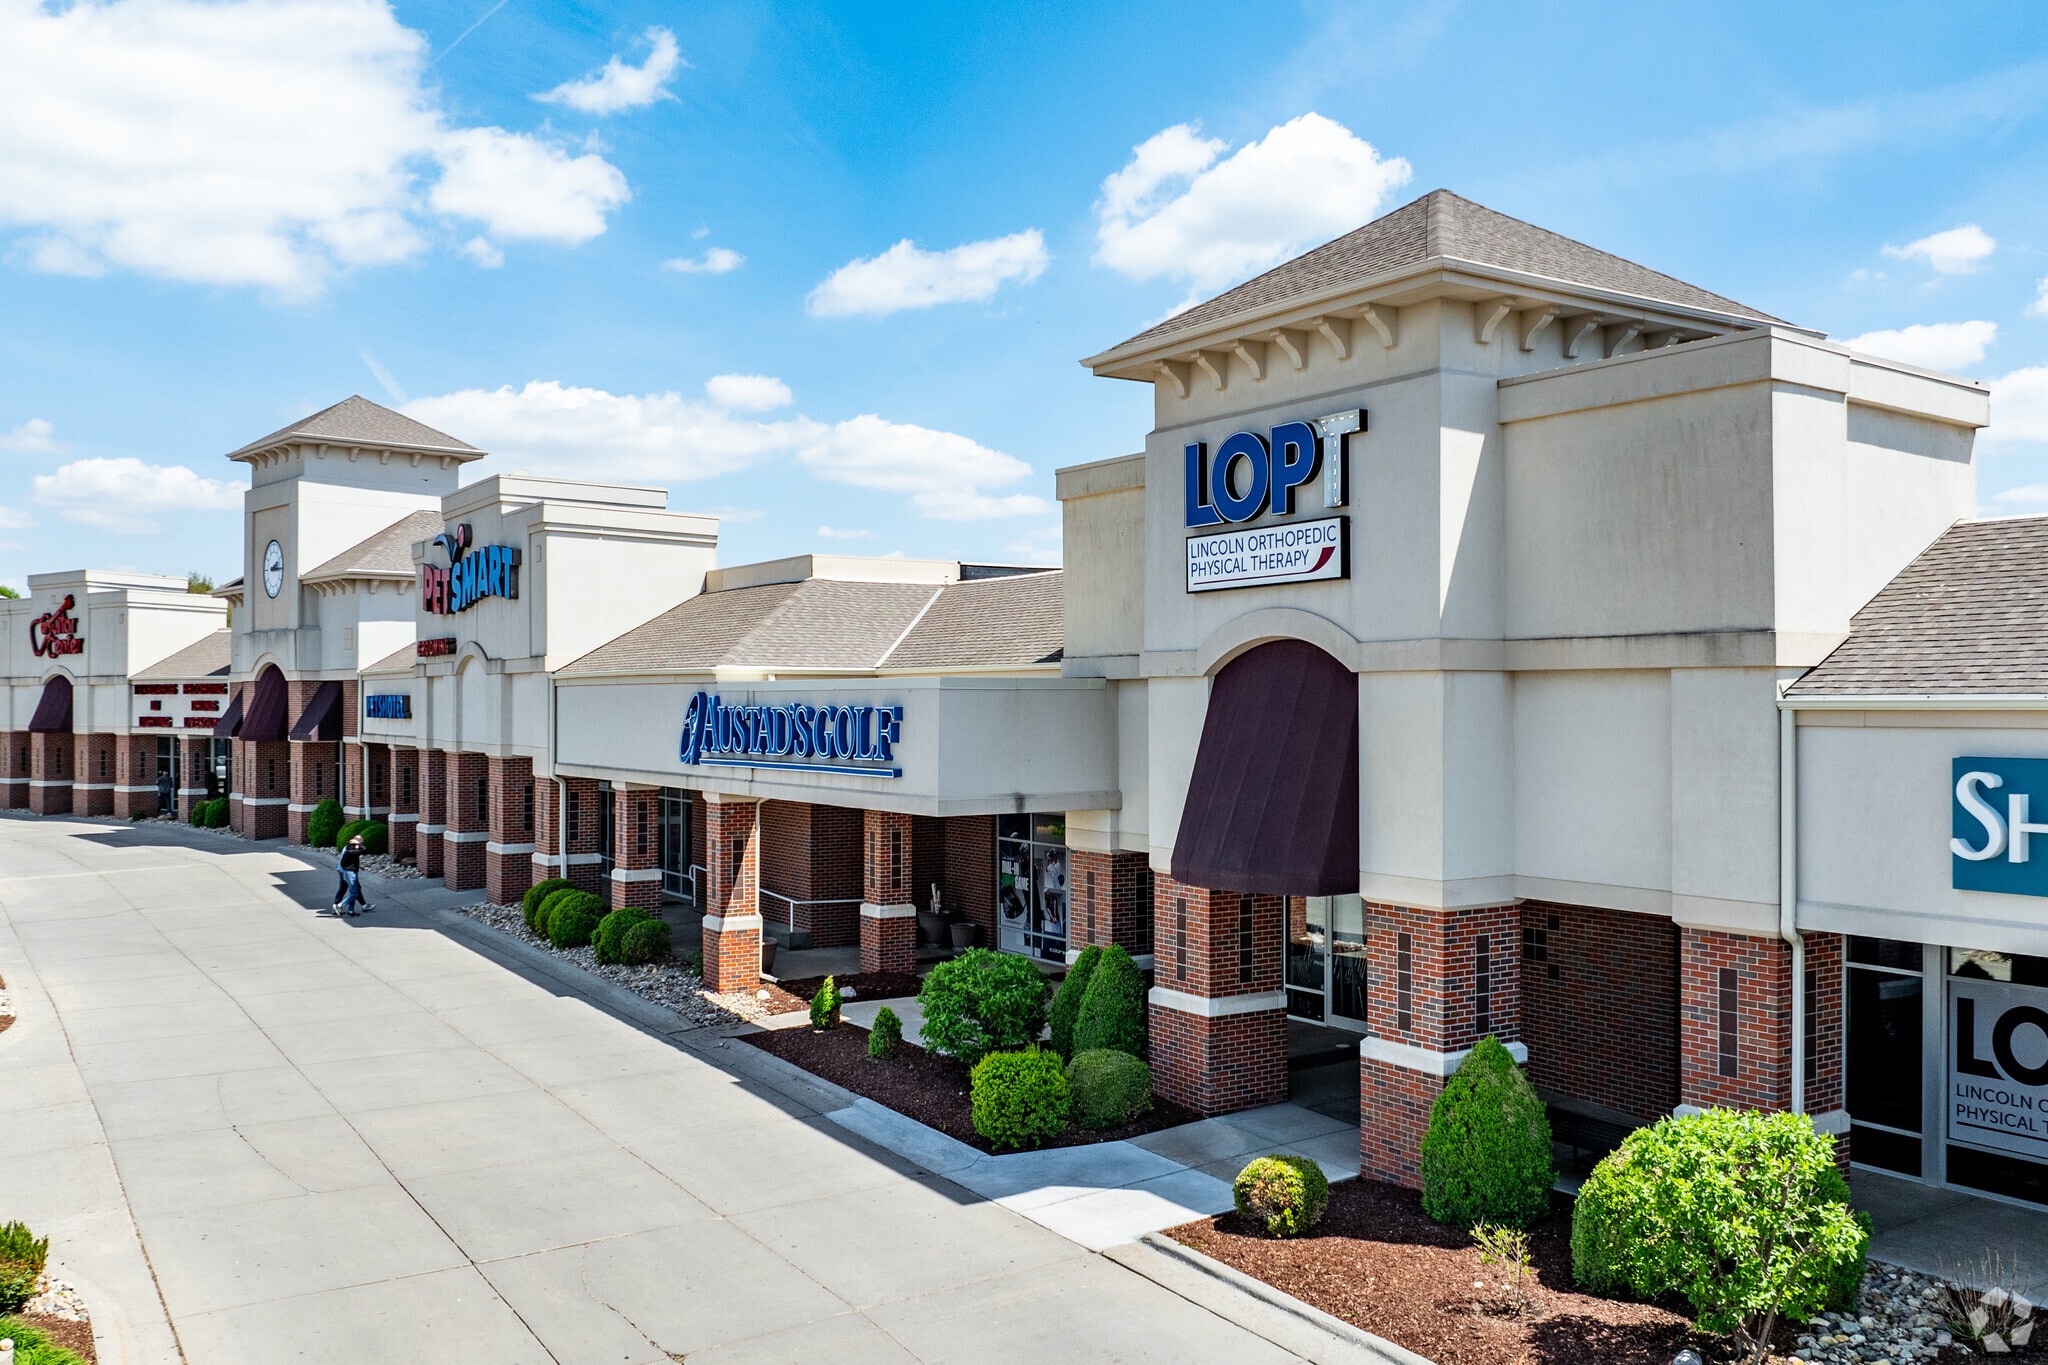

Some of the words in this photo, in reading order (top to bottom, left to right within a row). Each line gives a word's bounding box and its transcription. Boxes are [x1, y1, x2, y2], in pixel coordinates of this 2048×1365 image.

[1184, 408, 1368, 529] LOPT
[1190, 537, 1244, 559] LINCOLN
[1247, 525, 1337, 551] ORTHOPEDIC
[1190, 557, 1248, 577] PHYSICAL
[1250, 549, 1310, 570] THERAPY
[46, 634, 84, 658] Center
[812, 705, 904, 762] GOLF
[1956, 1084, 2032, 1109] LINCOLN
[1956, 1104, 2038, 1132] PHYSICAL
